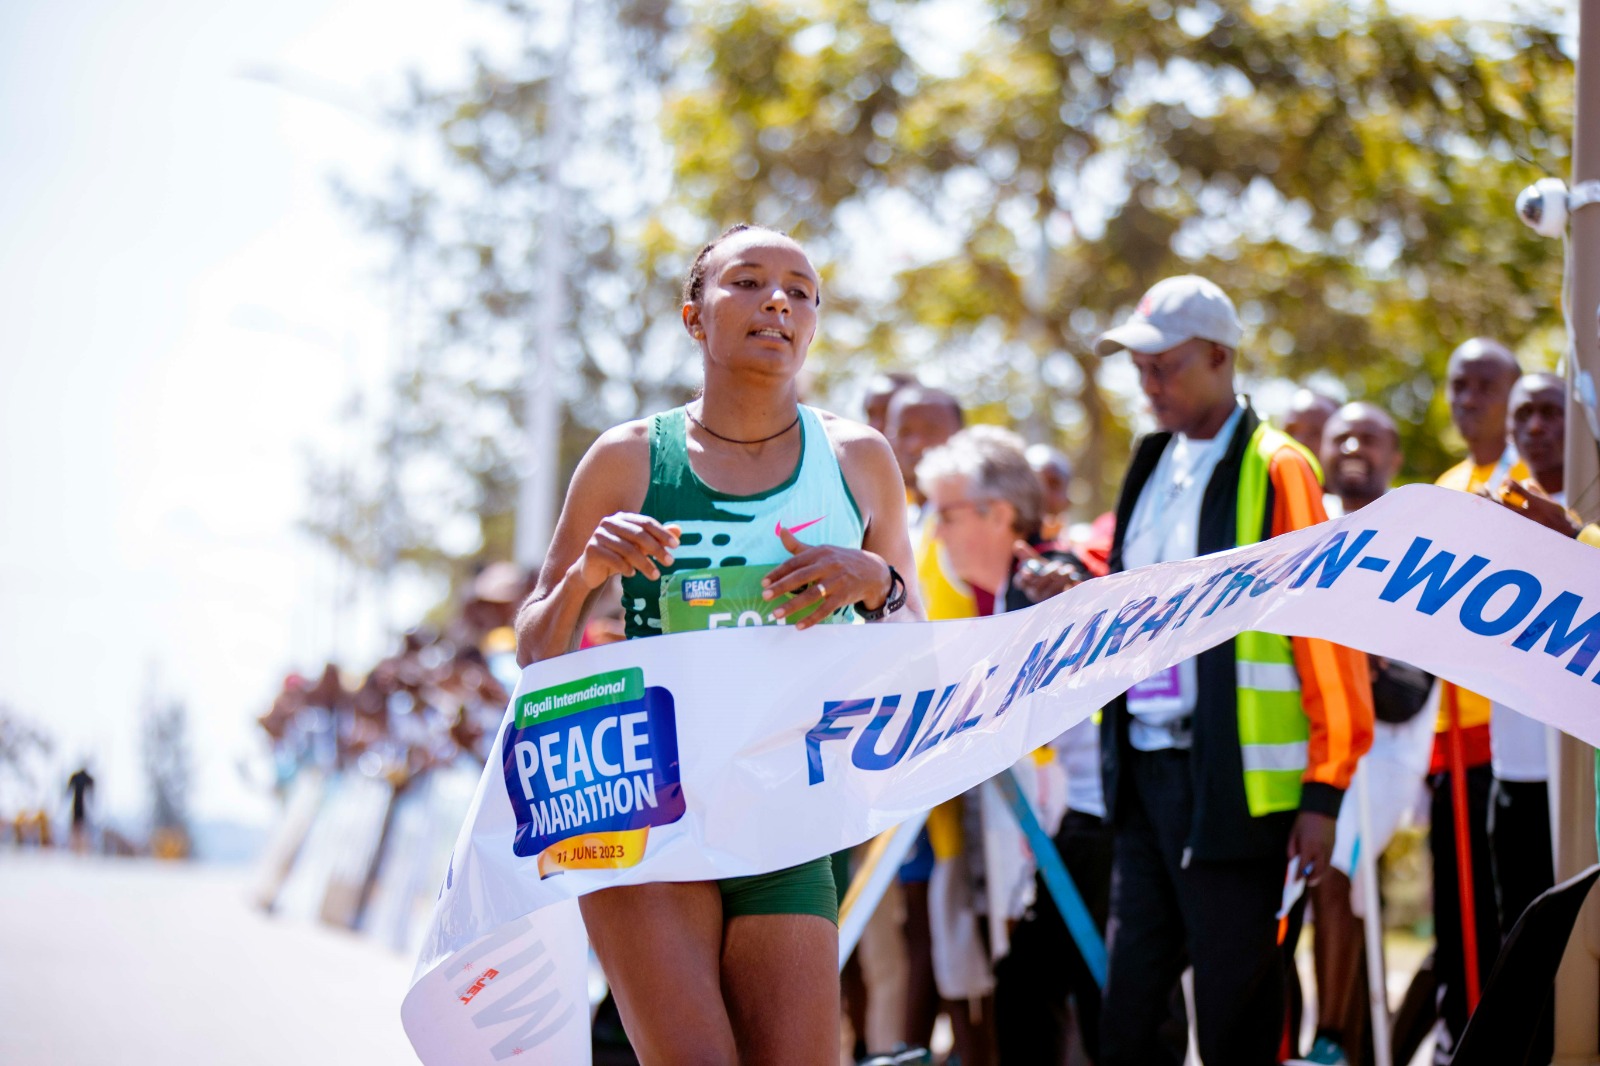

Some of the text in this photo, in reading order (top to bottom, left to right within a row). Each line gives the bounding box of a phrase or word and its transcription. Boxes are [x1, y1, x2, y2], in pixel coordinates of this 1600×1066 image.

[685, 579, 716, 592] PEACE
[523, 677, 626, 718] Kigali International
[805, 664, 999, 786] FULL
[514, 711, 653, 800] PEACE
[529, 772, 659, 838] MARATHON
[570, 845, 598, 861] JUNE
[599, 844, 625, 859] 2023
